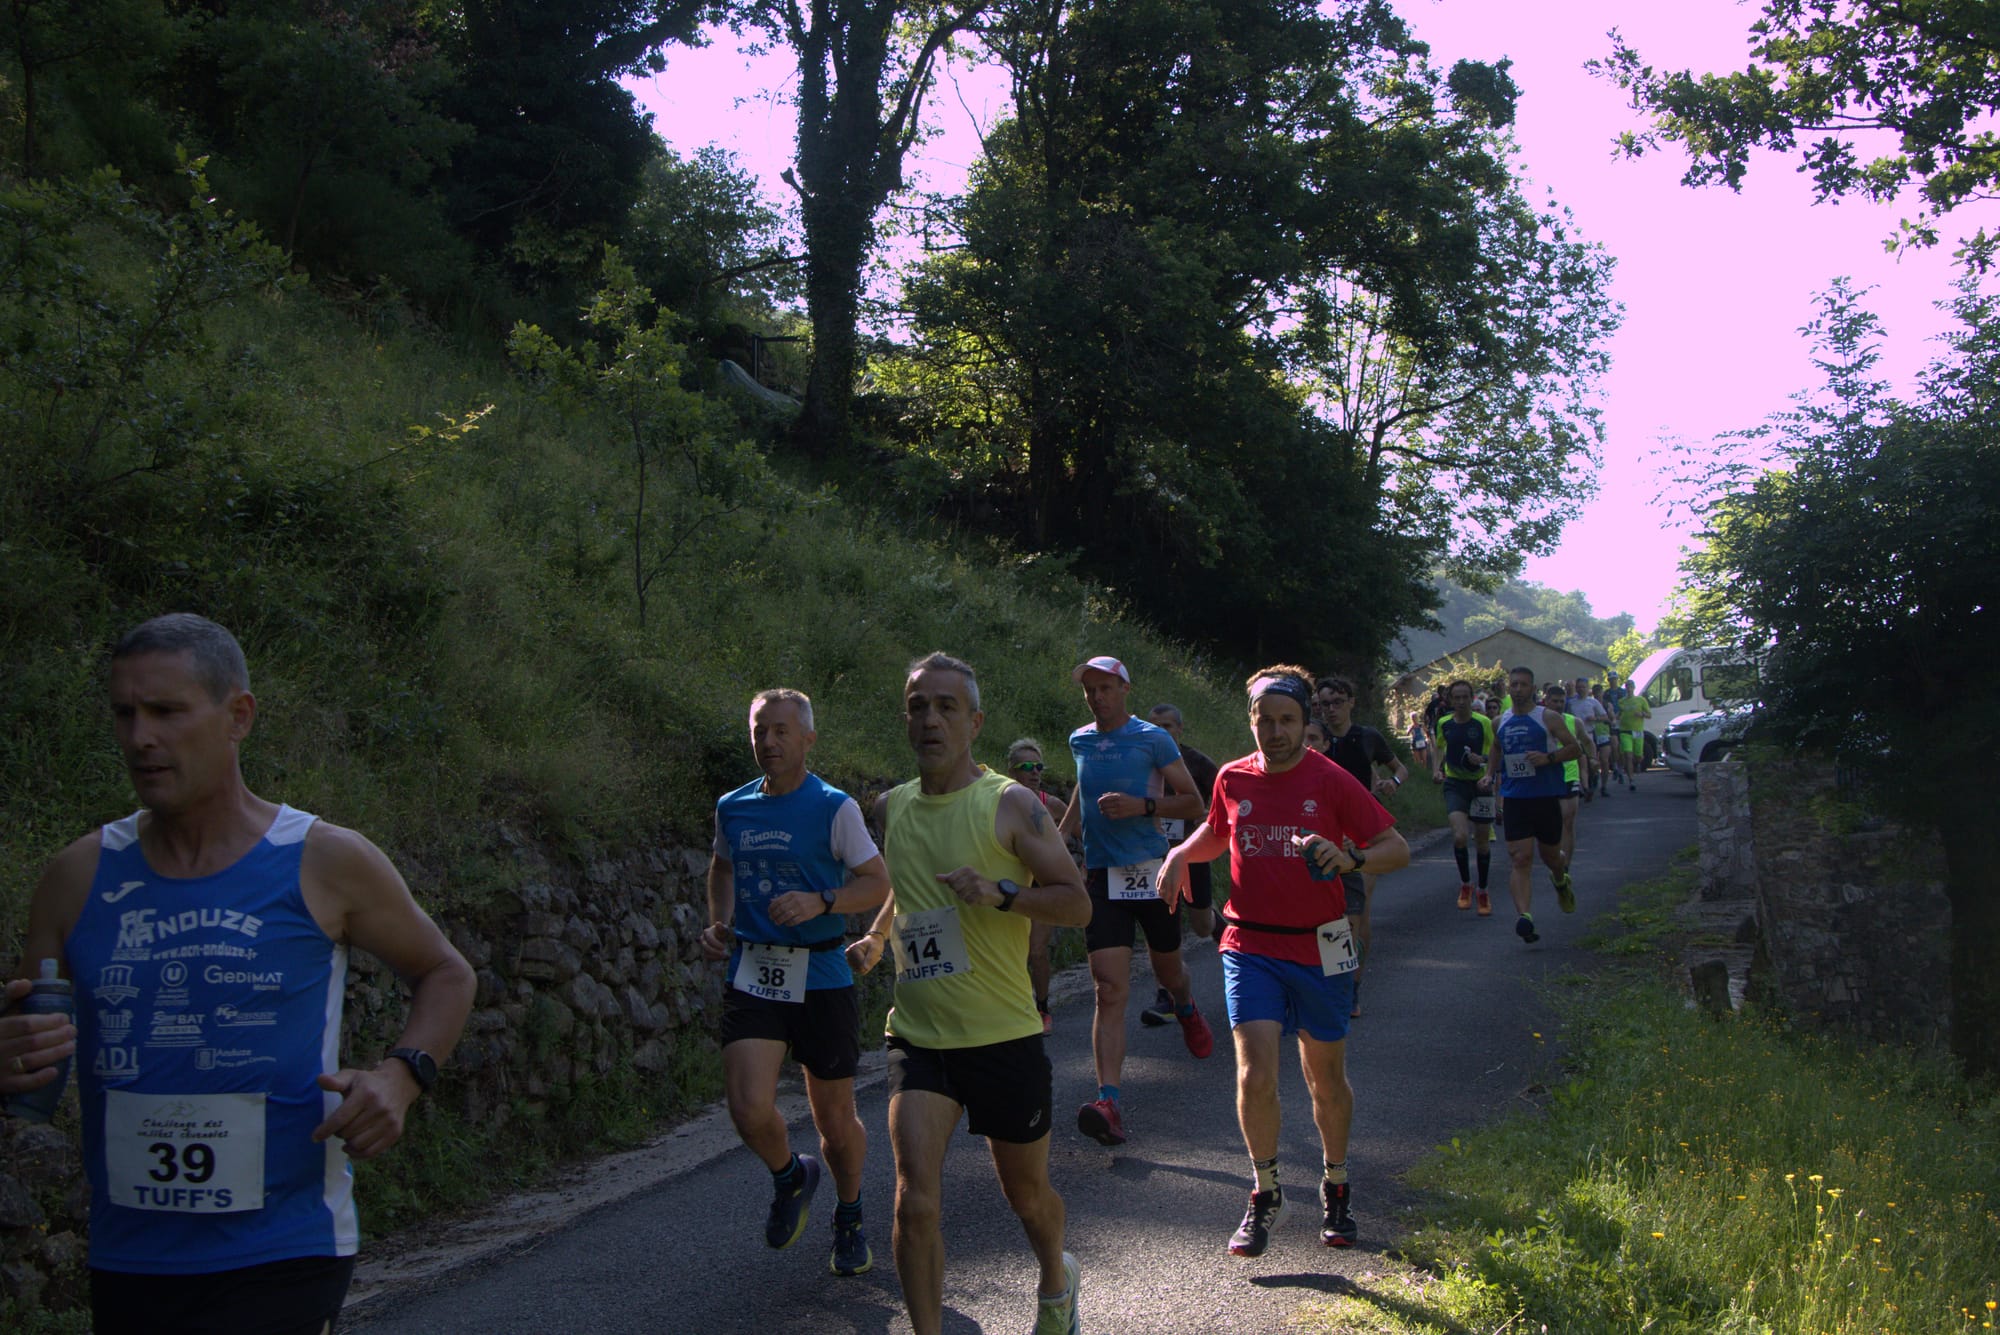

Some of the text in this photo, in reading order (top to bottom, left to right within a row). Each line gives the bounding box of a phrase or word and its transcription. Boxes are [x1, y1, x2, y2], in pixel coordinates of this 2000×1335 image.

[1266, 825, 1299, 842] JUST
[1124, 876, 1149, 890] 24
[1119, 891, 1155, 899] TUFF'S
[908, 937, 941, 964] 14
[758, 966, 785, 987] 38
[905, 962, 954, 979] TUFF'S
[748, 984, 792, 1000] TUFF'S
[148, 1142, 215, 1183] 39
[134, 1186, 233, 1208] TUFF'S
